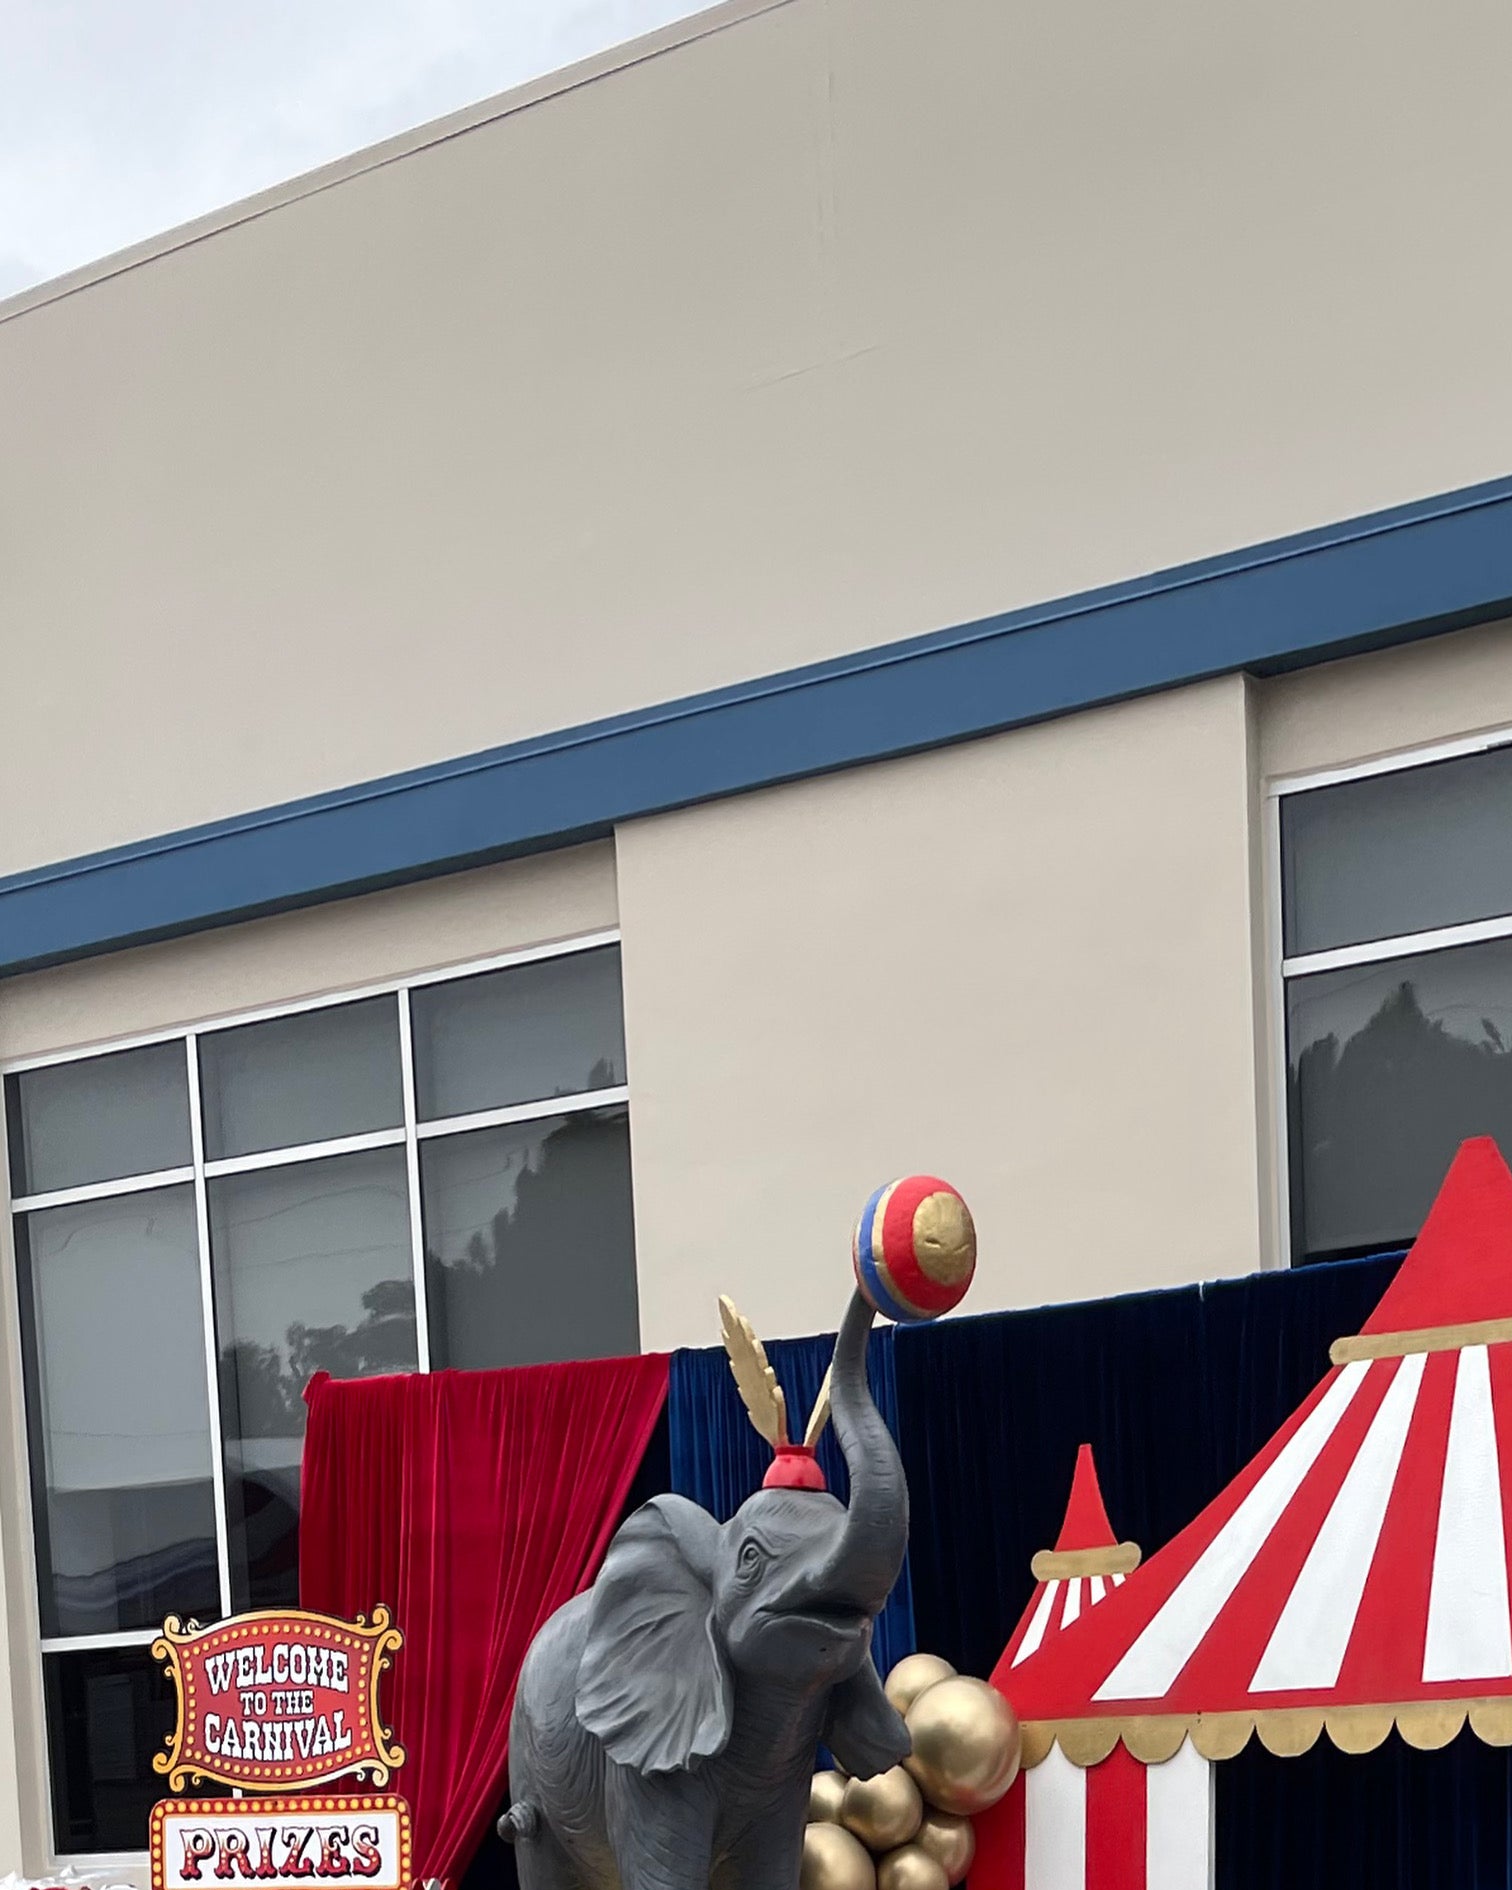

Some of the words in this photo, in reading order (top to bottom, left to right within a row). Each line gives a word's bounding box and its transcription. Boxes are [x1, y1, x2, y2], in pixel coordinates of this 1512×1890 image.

[204, 1643, 349, 1695] WELCOME
[239, 1691, 267, 1716] TO
[272, 1690, 314, 1715] THE
[204, 1710, 352, 1762] CARNIVAL
[179, 1825, 382, 1880] PRIZES
